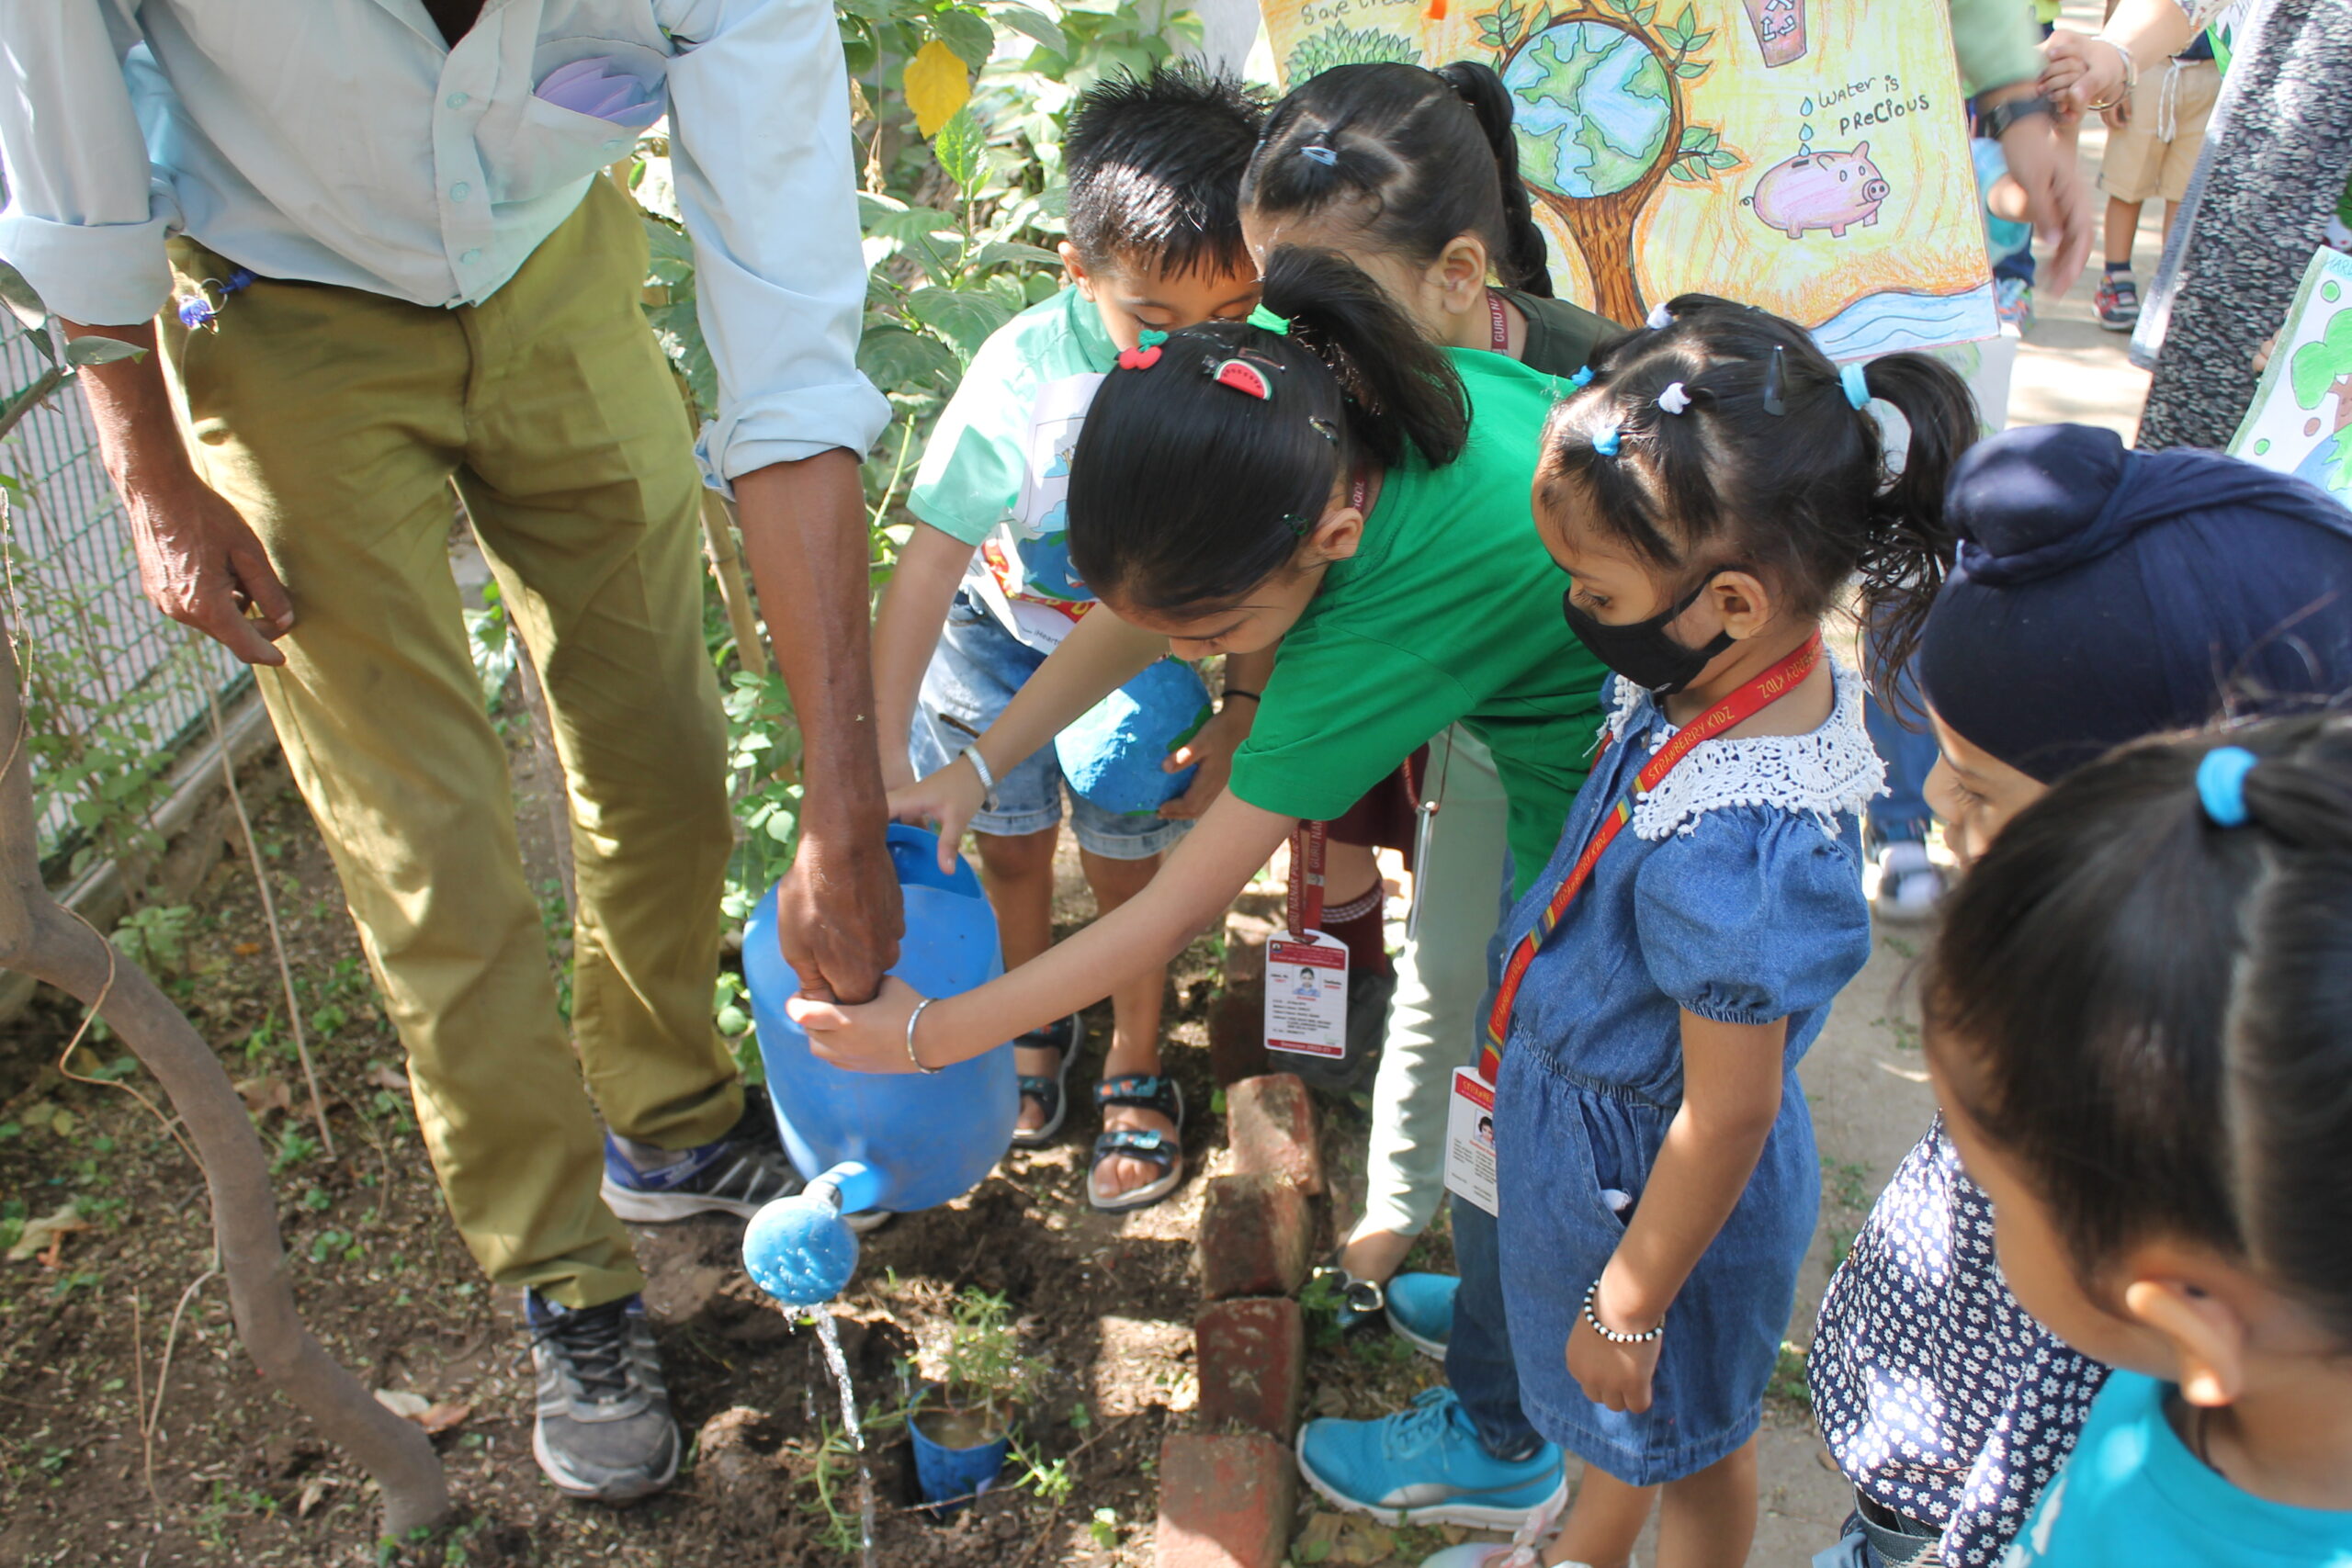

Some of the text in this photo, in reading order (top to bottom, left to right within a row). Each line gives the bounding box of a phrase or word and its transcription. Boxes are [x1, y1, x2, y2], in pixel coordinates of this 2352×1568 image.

[1301, 1, 1351, 26] Save
[1884, 75, 1899, 93] is
[1493, 312, 1506, 343] GURU
[1034, 629, 1061, 646] iHeart
[1757, 674, 1785, 699] KIDZ
[1647, 705, 1736, 781] STRAWBERRY KIDZ
